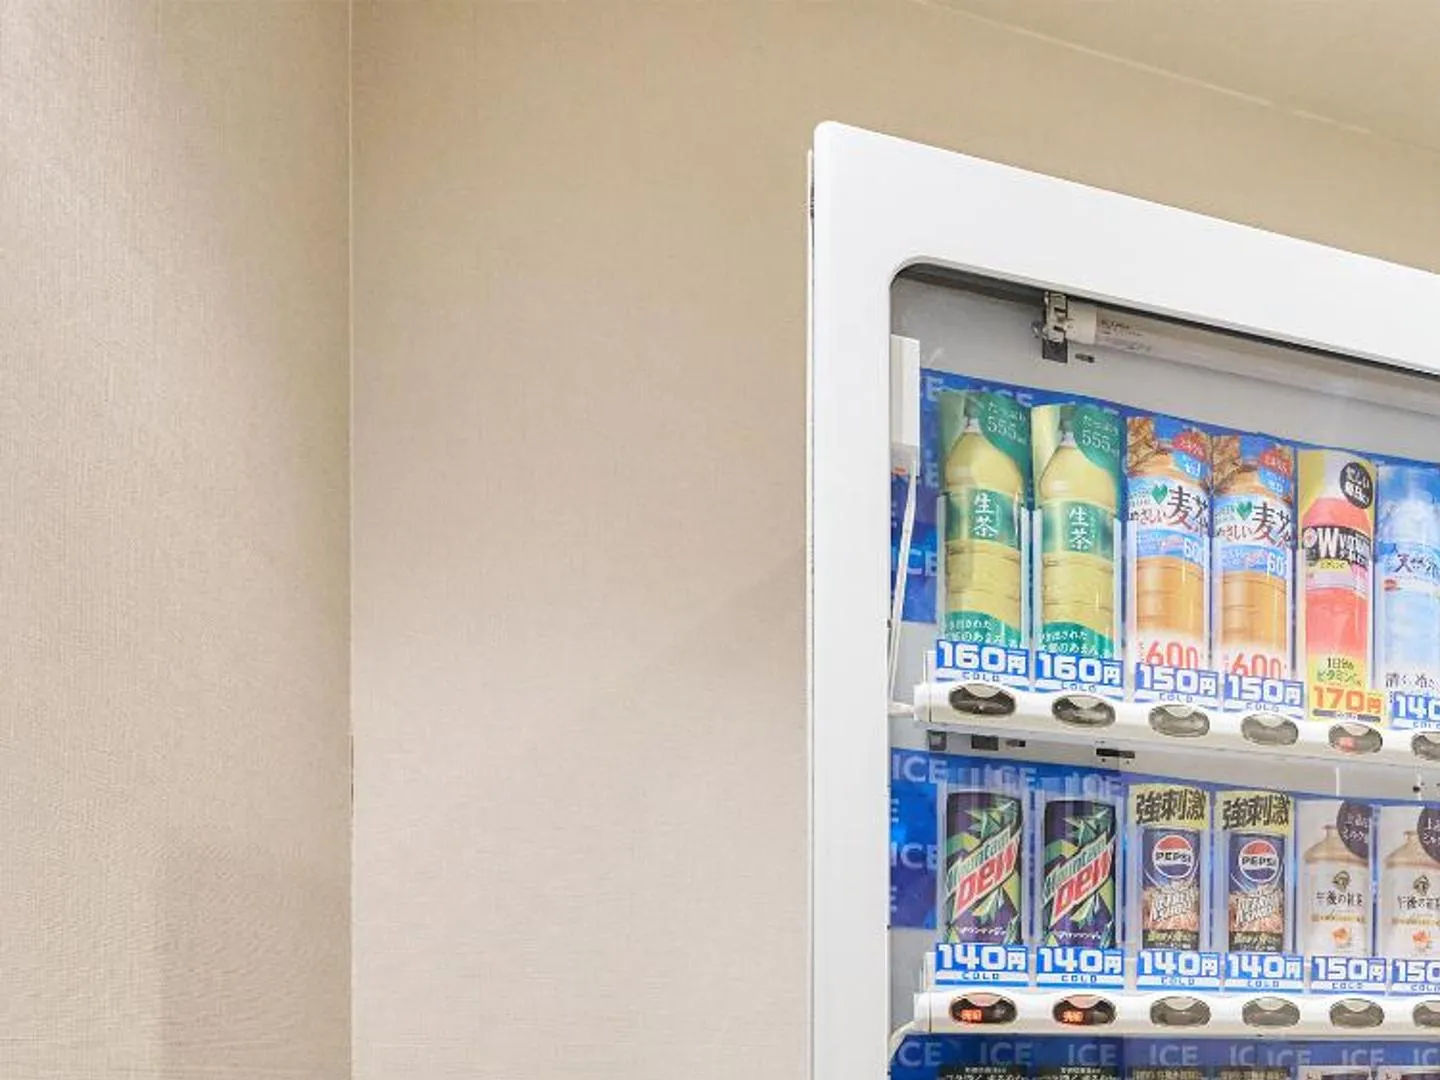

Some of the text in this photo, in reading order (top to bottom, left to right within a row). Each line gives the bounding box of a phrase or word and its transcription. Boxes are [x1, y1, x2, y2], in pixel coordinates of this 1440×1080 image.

[1069, 507, 1092, 550] 生茶
[939, 641, 1026, 674] 160円
[1038, 653, 1121, 685] 160円
[1140, 664, 1216, 696] 150円
[1230, 675, 1301, 705] 150円
[1314, 686, 1381, 714] 170円
[1155, 851, 1192, 863] PEPSI
[1241, 856, 1277, 867] PEPSI
[938, 945, 1026, 971] 140円
[1038, 948, 1122, 974] 140円
[1140, 952, 1218, 976] 140円
[1228, 954, 1302, 978] 140円
[1314, 957, 1384, 981] 150円
